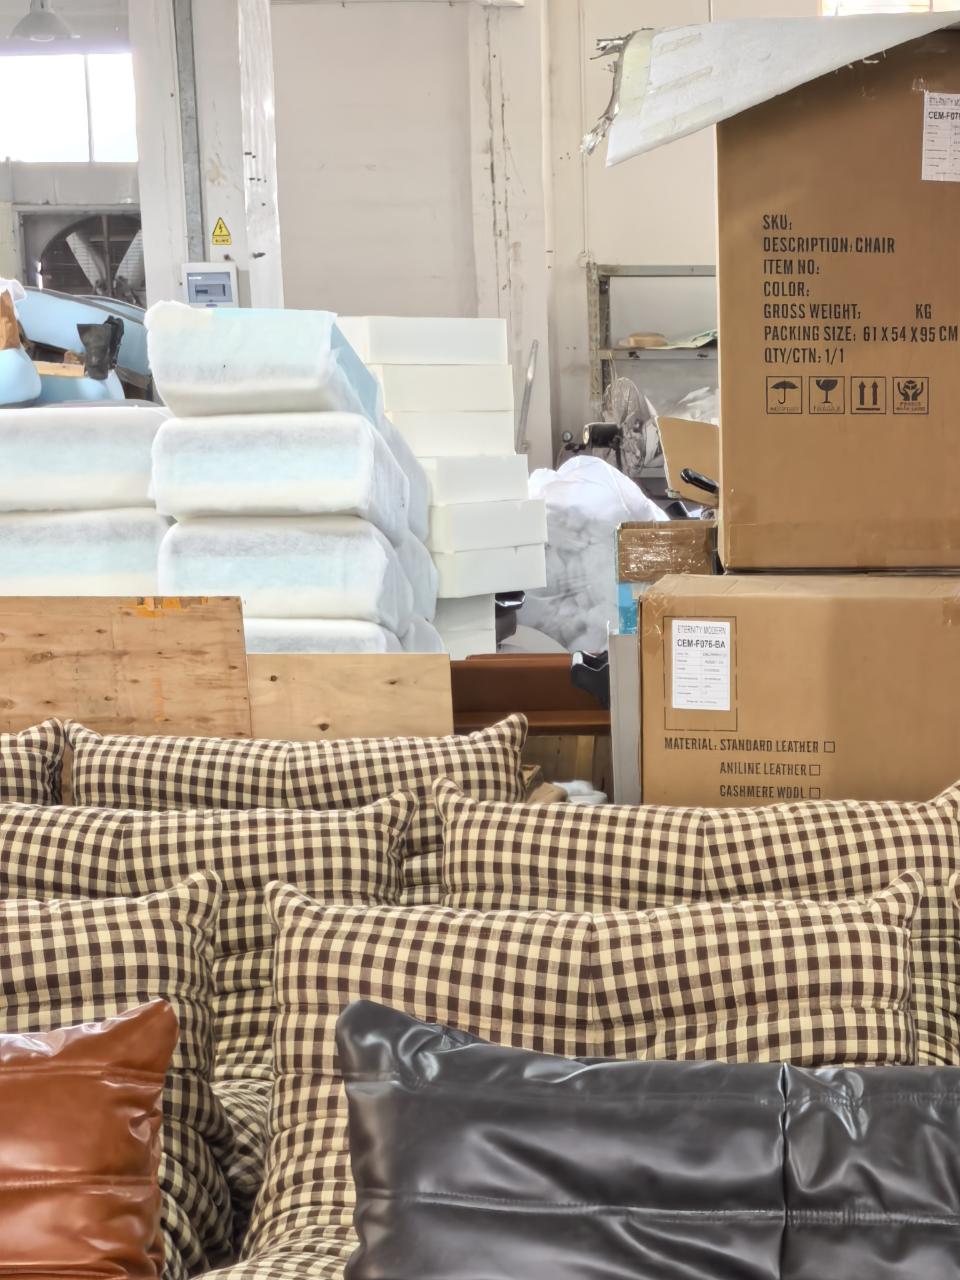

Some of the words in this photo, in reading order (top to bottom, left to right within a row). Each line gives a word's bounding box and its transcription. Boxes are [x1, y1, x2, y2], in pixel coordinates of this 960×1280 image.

[762, 214, 792, 231] SKU:
[855, 237, 895, 254] CHAIR
[763, 259, 793, 275] ITEM
[798, 259, 820, 275] NO:
[763, 281, 810, 297] COLOR:
[763, 303, 805, 319] GROSS
[809, 303, 861, 320] WEIGHT:
[915, 303, 932, 319] KG
[764, 325, 820, 342] PACKING
[823, 326, 856, 342] SIZE:
[863, 326, 877, 342] 61
[891, 326, 906, 342] 54
[920, 326, 935, 343] 95
[939, 326, 958, 342] CM
[764, 347, 821, 365] QTY/CTN:
[825, 347, 844, 365] 1/1
[677, 638, 726, 649] CEM-F076-BA
[664, 736, 717, 751] MATERIAL:
[720, 738, 773, 752] STANDARD
[775, 740, 819, 753] LEATHER
[719, 761, 761, 776] ANILINE
[763, 763, 807, 776] LEATHER
[719, 784, 775, 798] CASHMERE
[777, 786, 805, 799] WOOL
